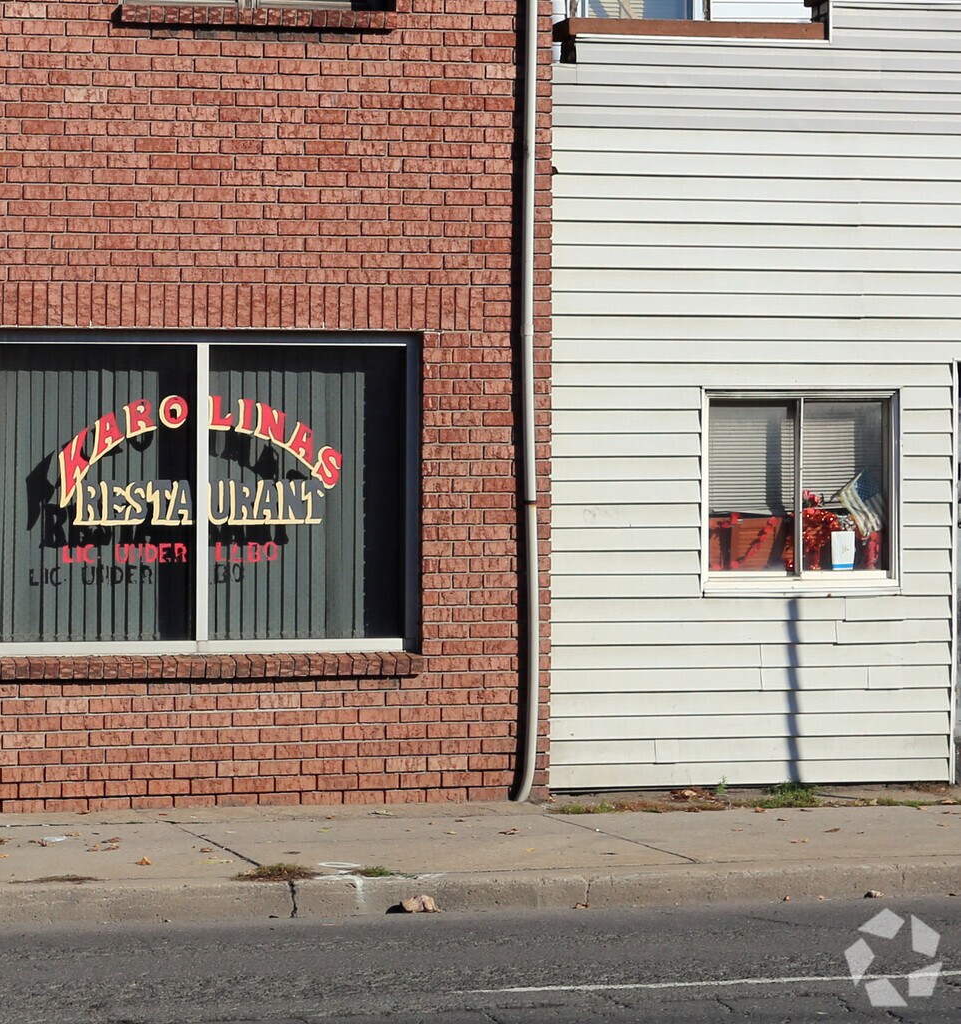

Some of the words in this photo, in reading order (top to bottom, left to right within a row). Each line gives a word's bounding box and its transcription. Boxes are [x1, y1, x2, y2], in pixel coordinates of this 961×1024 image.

[58, 394, 344, 509] KAROLINAS
[73, 479, 326, 526] RESTAURANT
[114, 542, 188, 564] UNDER
